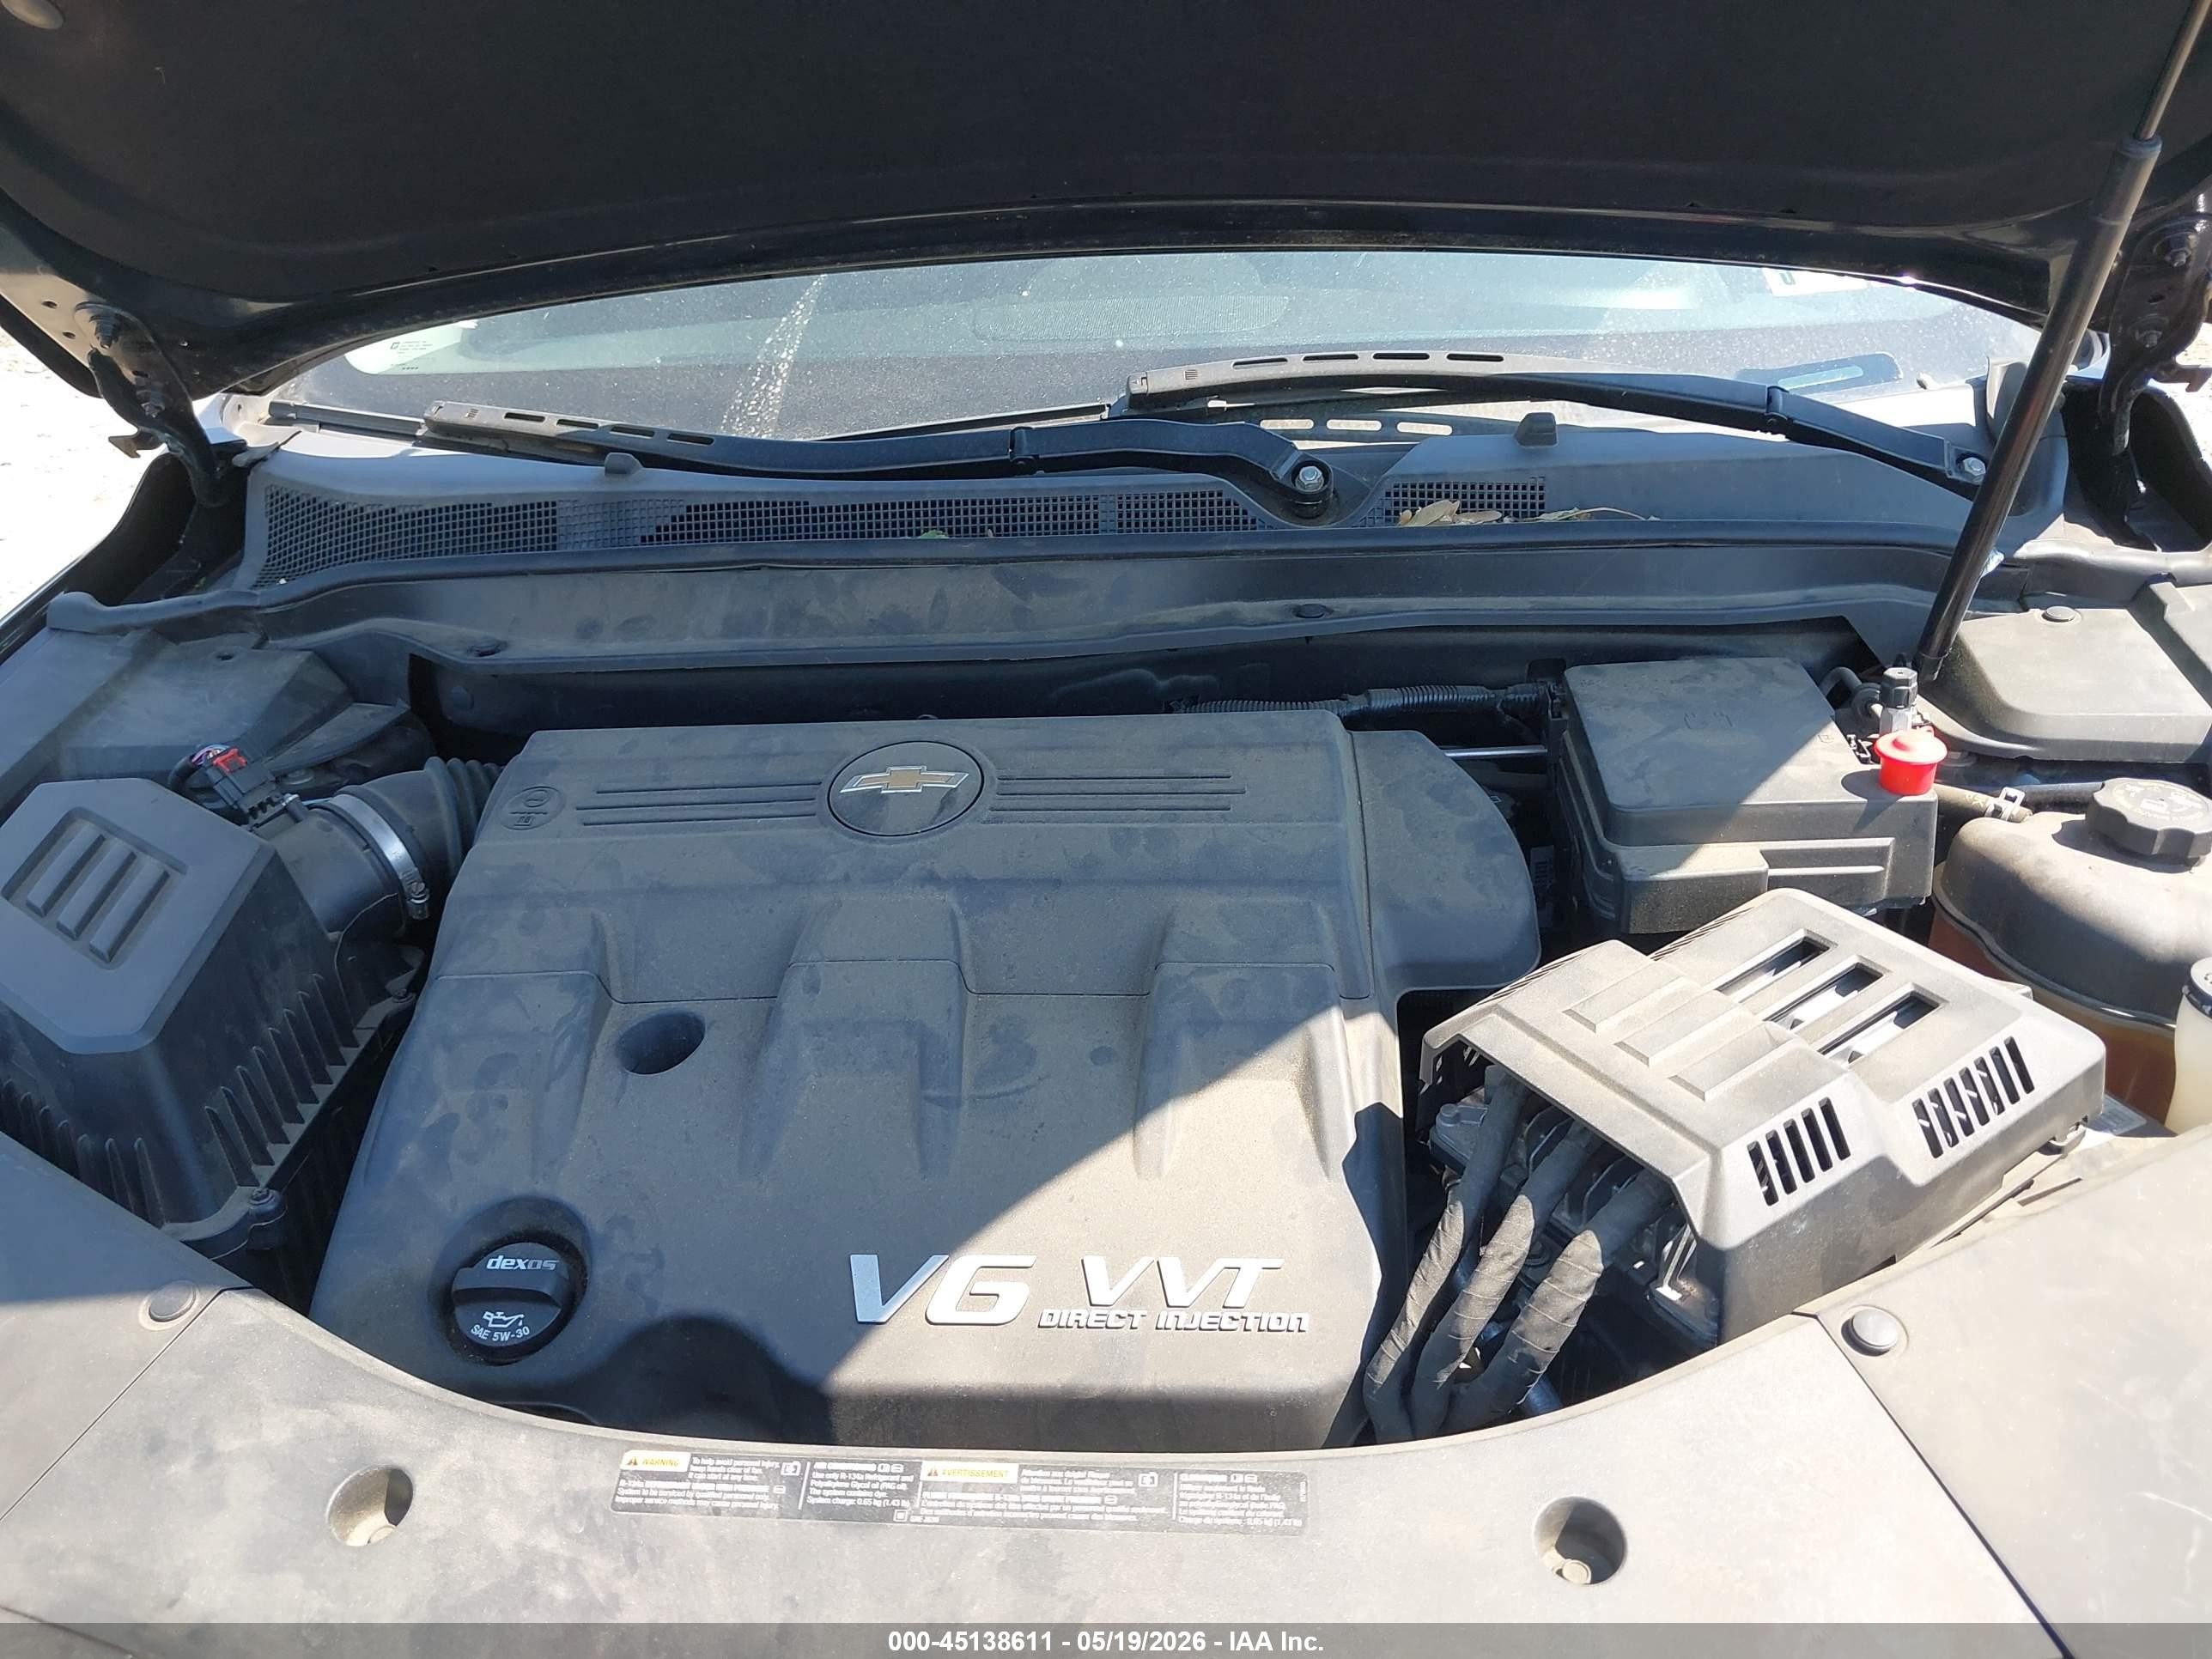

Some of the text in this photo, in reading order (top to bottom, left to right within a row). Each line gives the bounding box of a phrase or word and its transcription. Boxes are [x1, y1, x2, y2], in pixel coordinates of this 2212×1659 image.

[486, 1255, 560, 1270] dexos
[850, 1255, 1285, 1326] V6 VVT
[1037, 1309, 1310, 1333] DIRECT INJECTION
[471, 1324, 530, 1341] SAE 5W-30
[642, 1458, 680, 1467] WARNING
[942, 1468, 1010, 1478] AVERTISSEMENT
[617, 1487, 641, 1496] System
[807, 1496, 831, 1504] System
